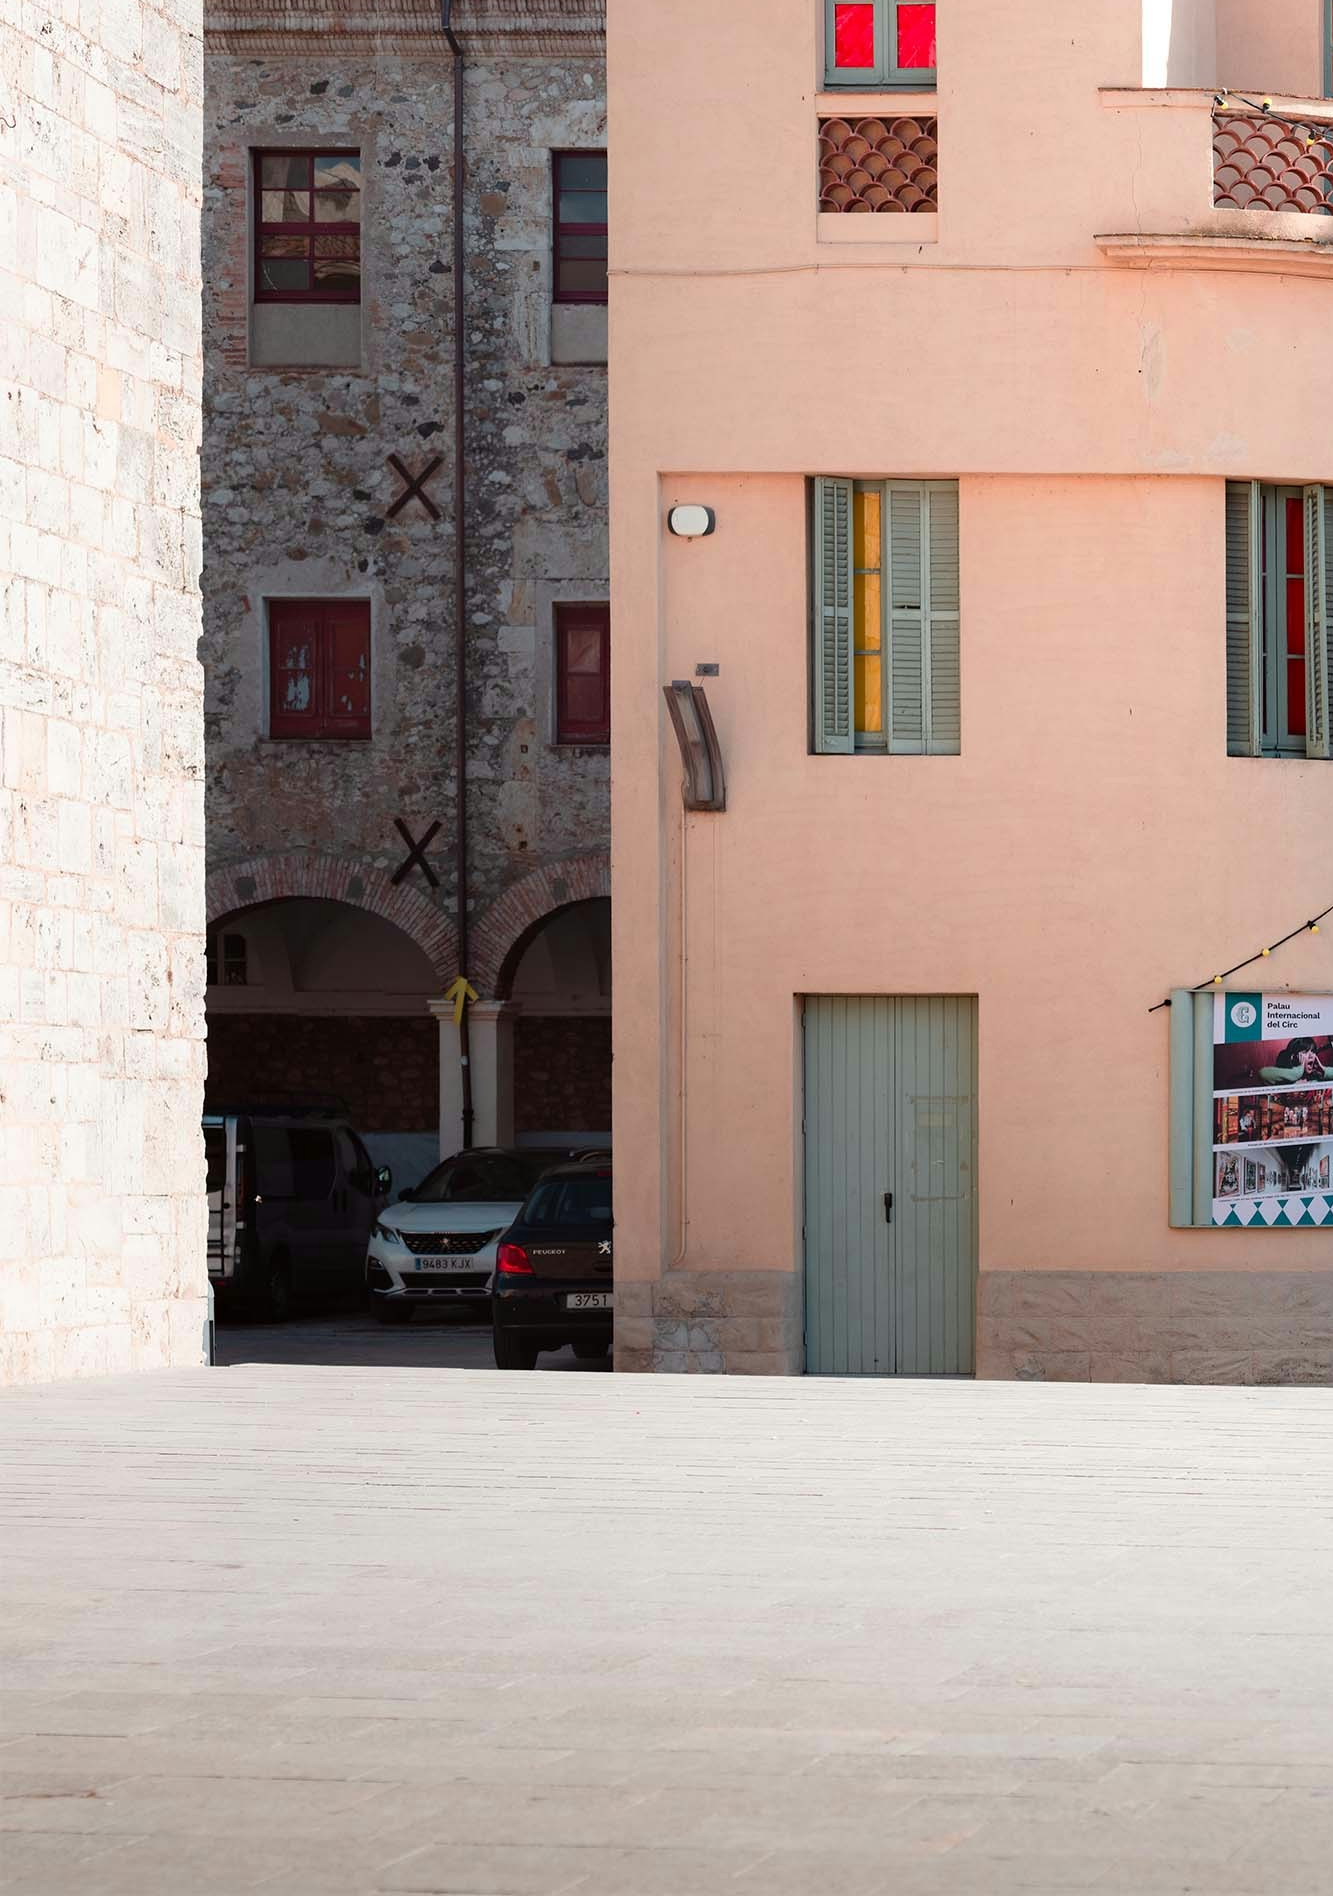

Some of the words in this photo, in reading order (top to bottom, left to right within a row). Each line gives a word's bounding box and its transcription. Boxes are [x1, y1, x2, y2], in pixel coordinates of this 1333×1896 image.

[1267, 1012, 1321, 1020] Internacional
[1267, 1021, 1280, 1029] del
[1281, 1021, 1299, 1029] Circ
[422, 1258, 449, 1269] 9483
[451, 1258, 471, 1269] KJX
[575, 1294, 608, 1307] 3751
